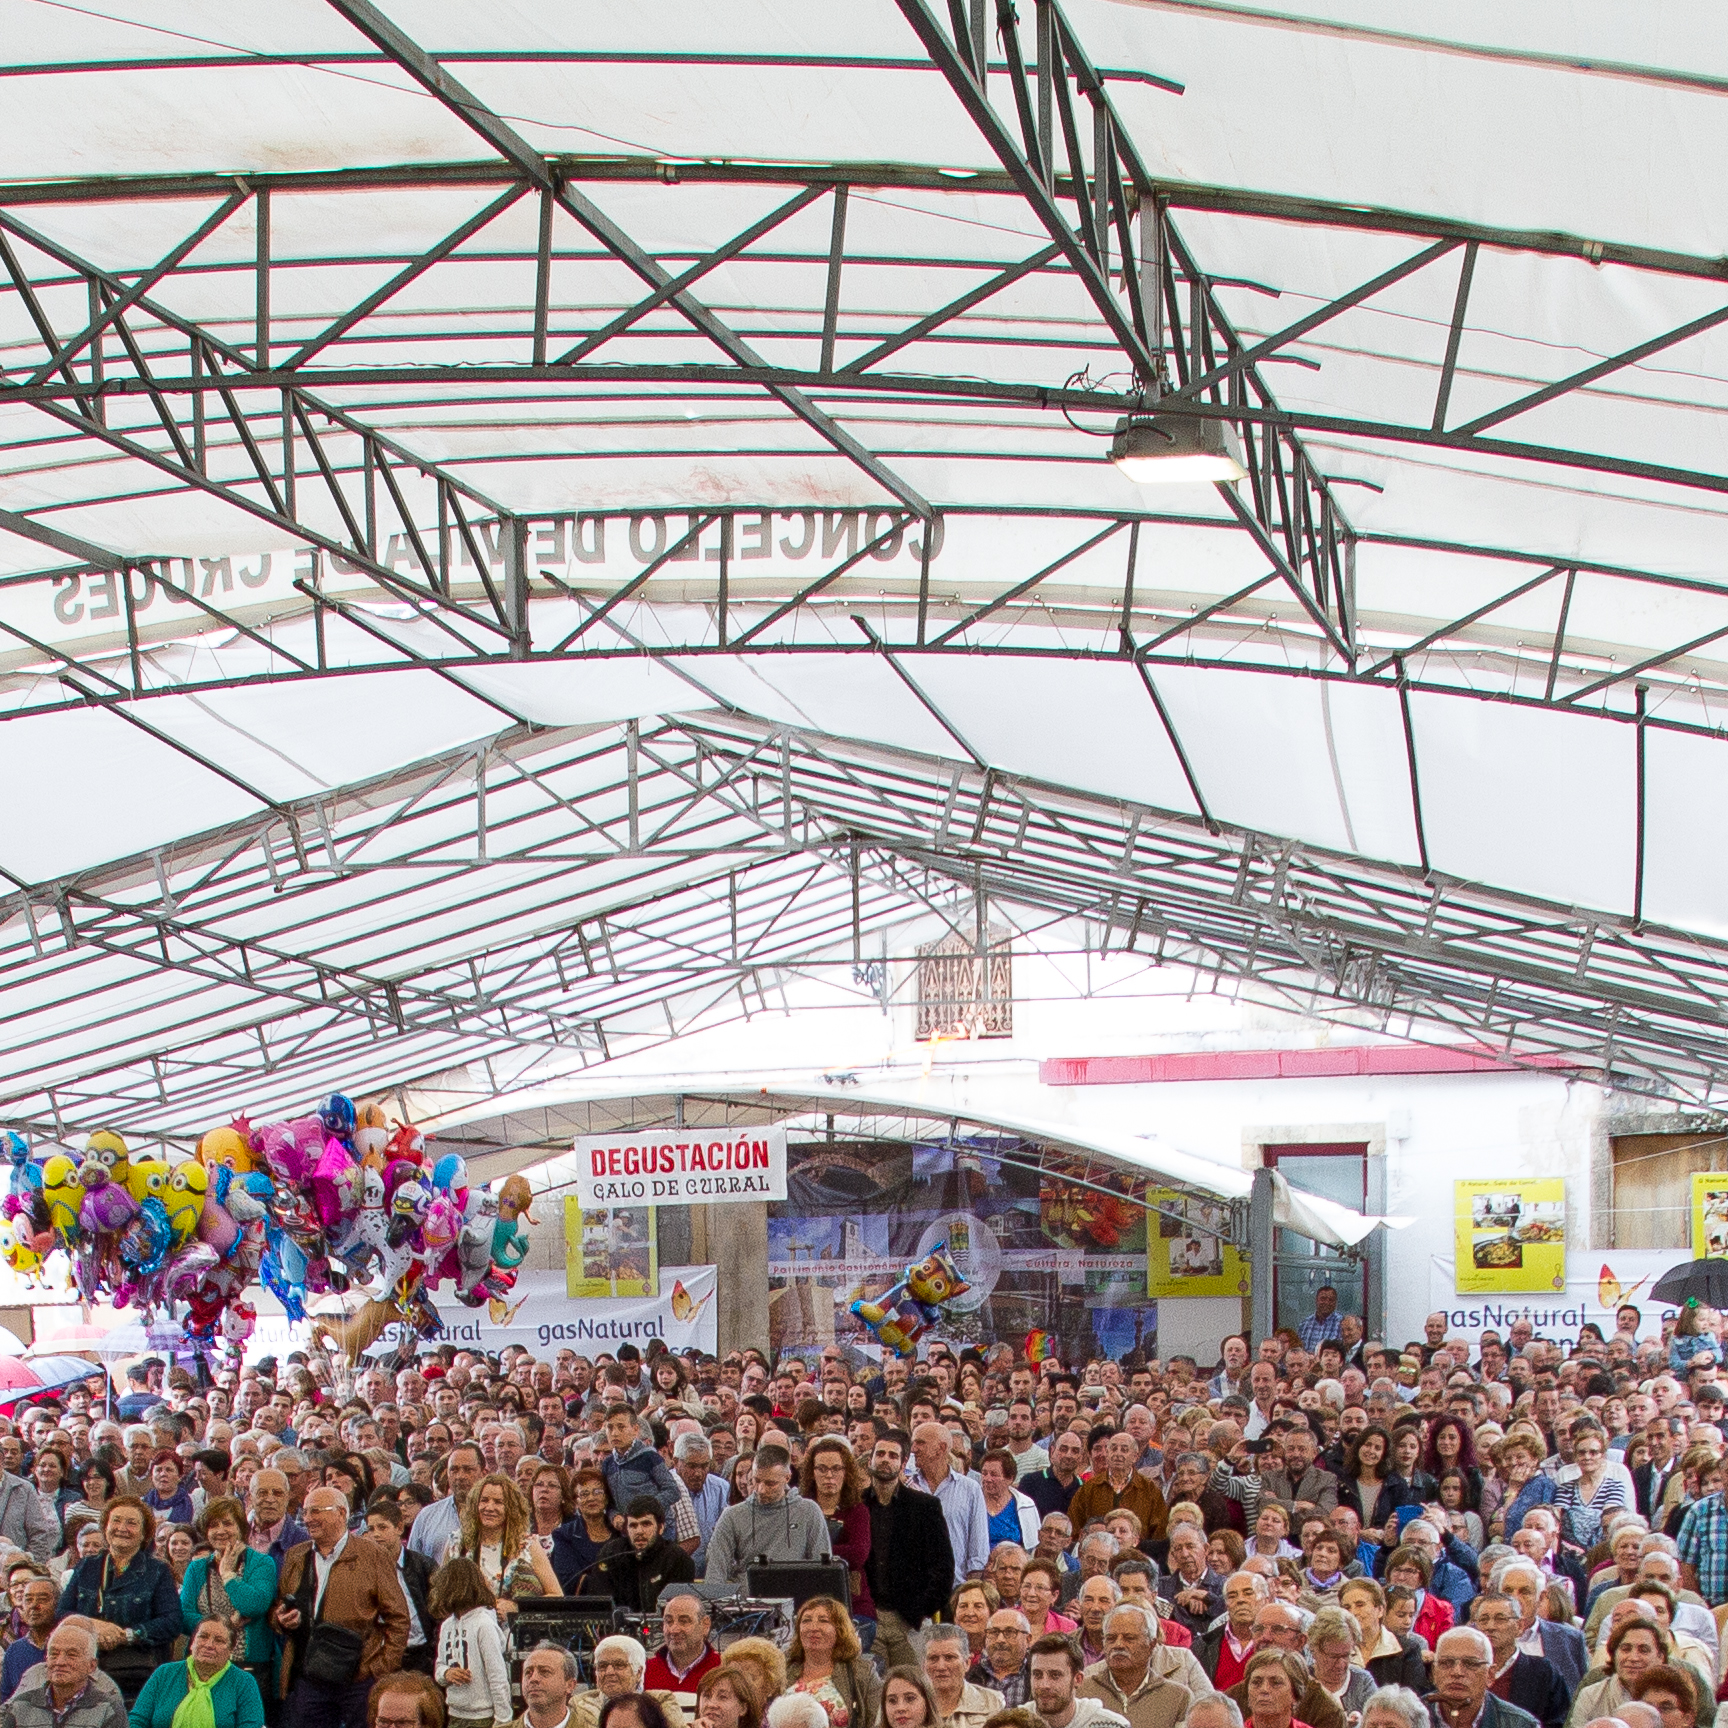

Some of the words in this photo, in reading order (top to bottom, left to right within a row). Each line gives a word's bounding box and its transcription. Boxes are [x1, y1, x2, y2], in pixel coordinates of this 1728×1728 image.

[590, 1133, 770, 1177] DEGUSTACIÓN
[593, 1181, 645, 1200] GALO
[652, 1179, 679, 1196] DE
[685, 1175, 770, 1195] CURRAL
[537, 1314, 665, 1346] gasNatural
